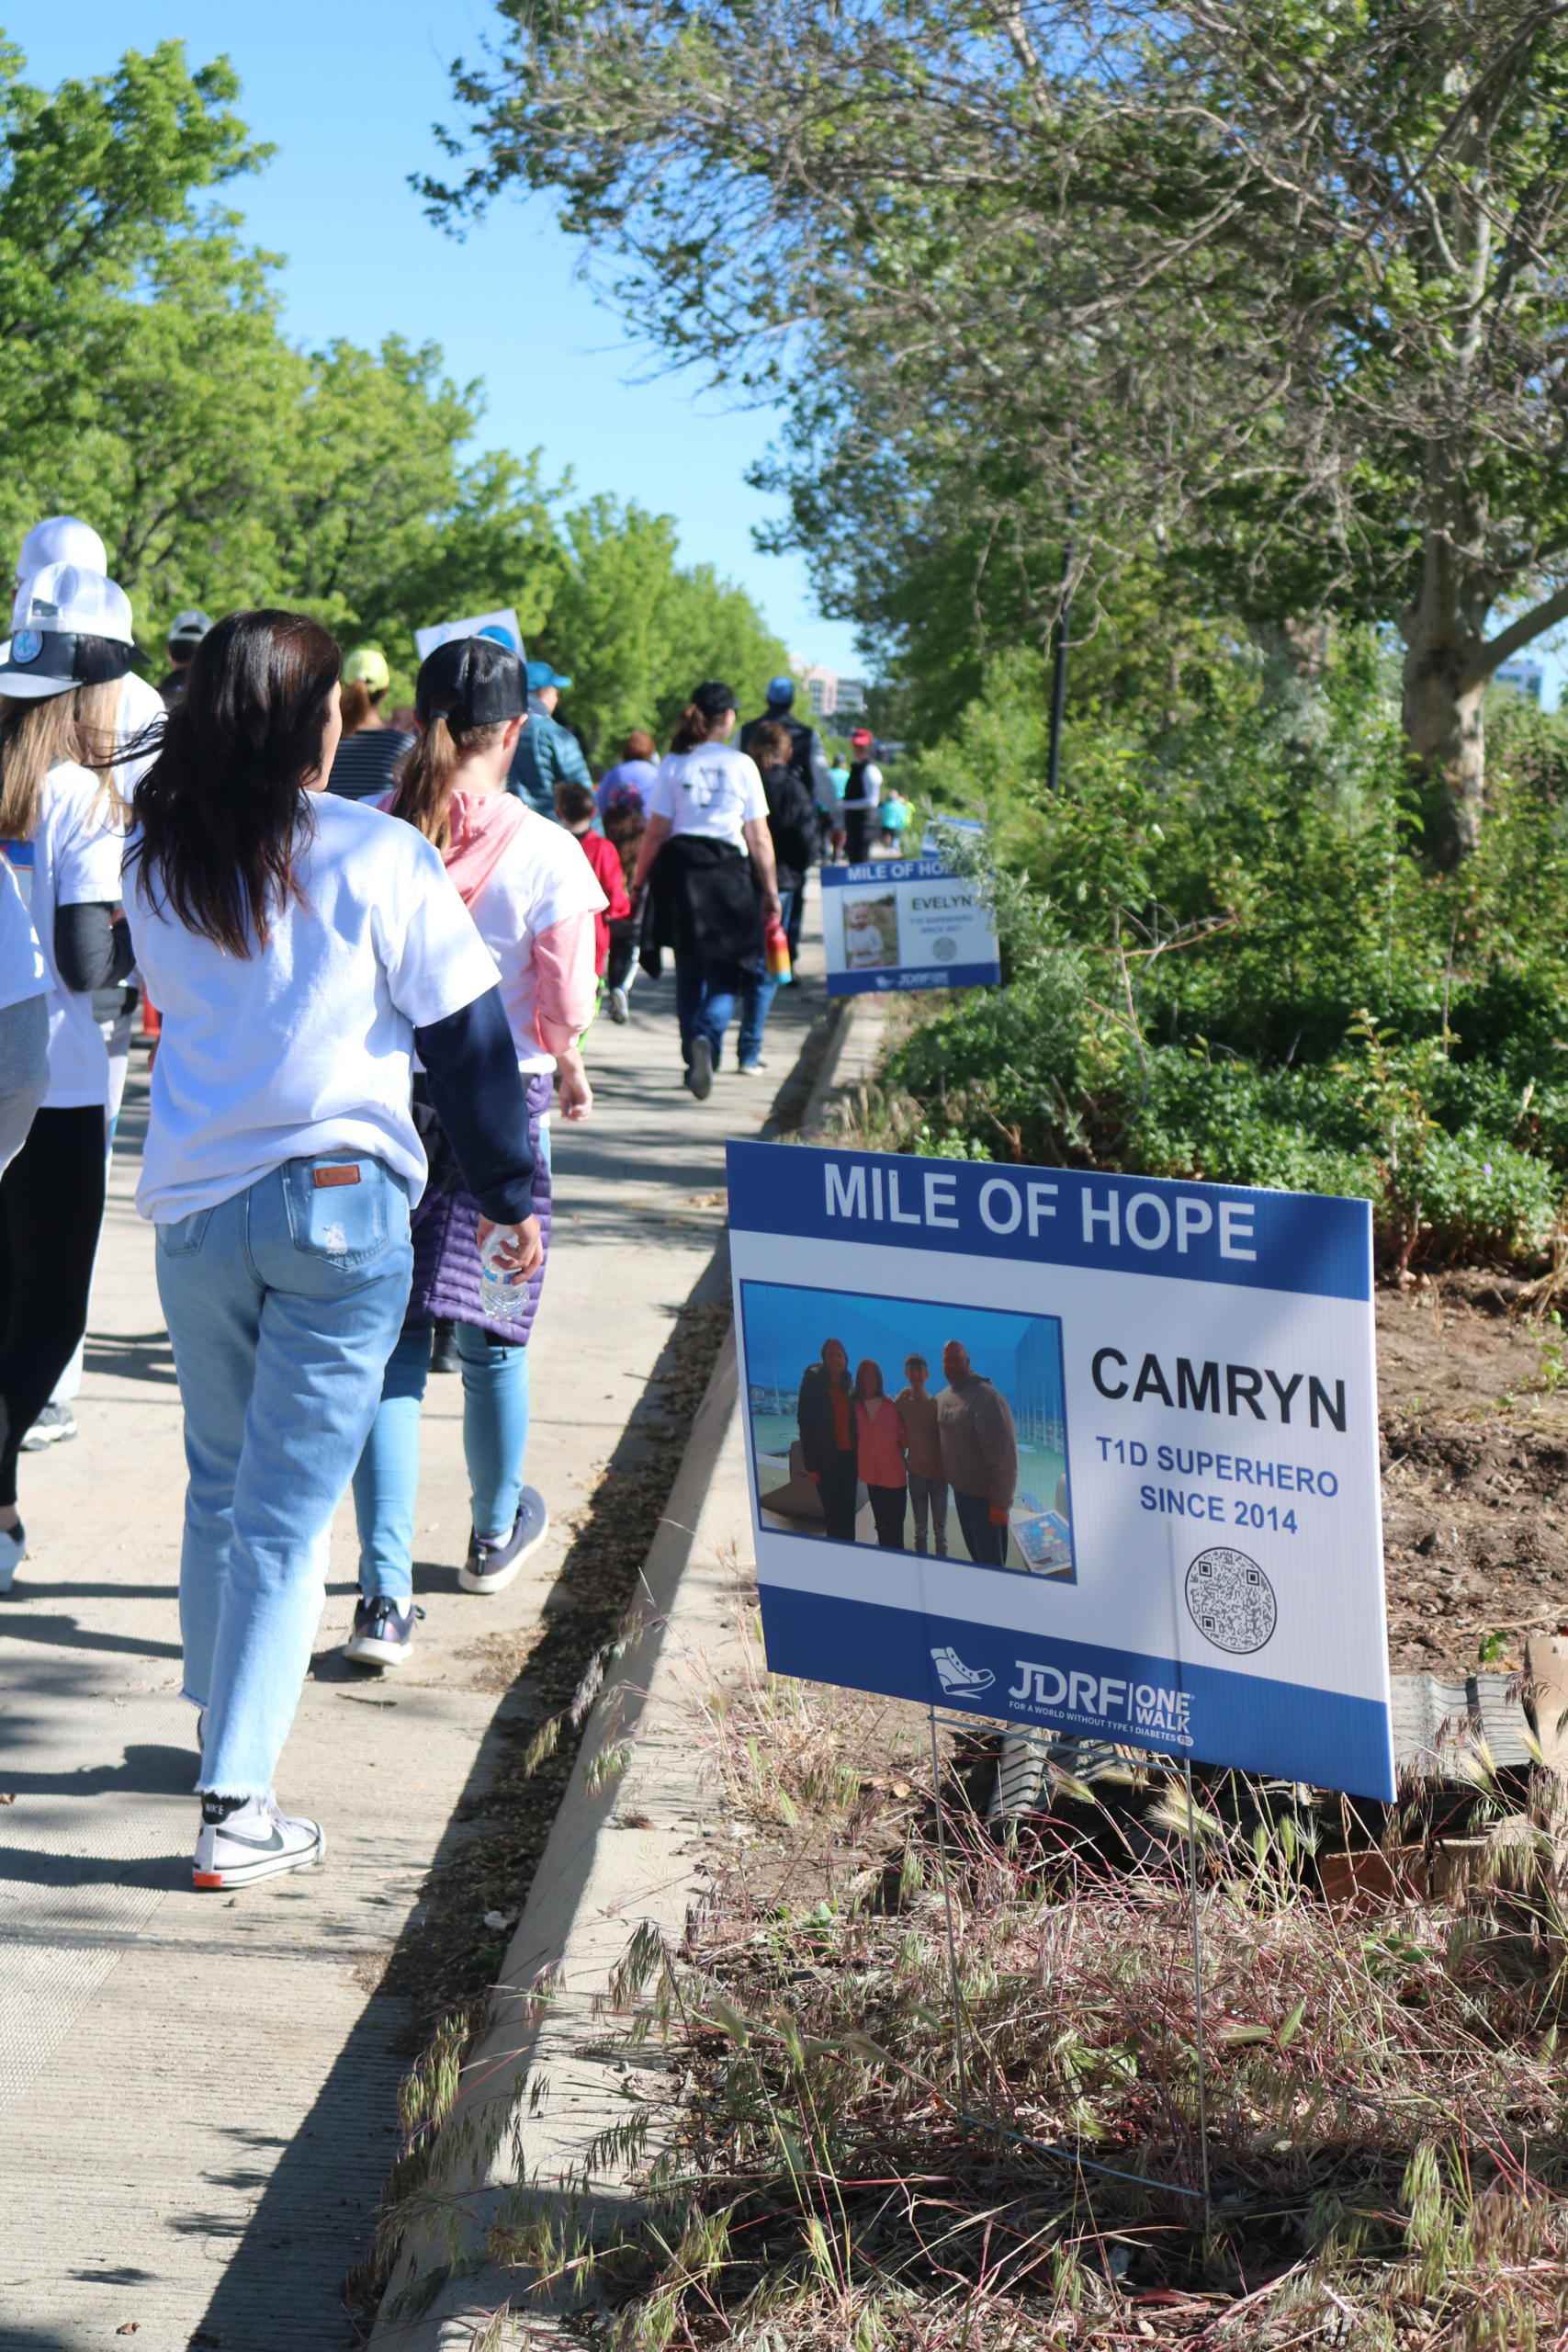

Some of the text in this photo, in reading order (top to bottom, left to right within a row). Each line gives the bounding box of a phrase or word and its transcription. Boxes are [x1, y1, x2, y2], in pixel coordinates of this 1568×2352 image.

[847, 865, 887, 881] MILE
[891, 863, 914, 878] OF
[911, 895, 972, 910] EVELYN
[824, 1163, 1258, 1261] MILE OF HOPE
[1091, 1347, 1347, 1433] CAMRYN
[1096, 1436, 1339, 1498] T1D SUPERHERO
[1140, 1485, 1298, 1534] SINCE 2014
[1008, 1659, 1127, 1716] JDRF
[1135, 1684, 1191, 1716] ONE
[1009, 1701, 1026, 1713] FOR
[1027, 1704, 1033, 1713] A
[1034, 1705, 1065, 1720] WORLD
[1066, 1713, 1105, 1727] WITHOUT
[1107, 1720, 1128, 1733] TYPE
[1129, 1725, 1134, 1734] 1
[1135, 1726, 1177, 1742] DIABETES
[1135, 1706, 1191, 1734] WALK
[206, 1803, 225, 1815] NIKE
